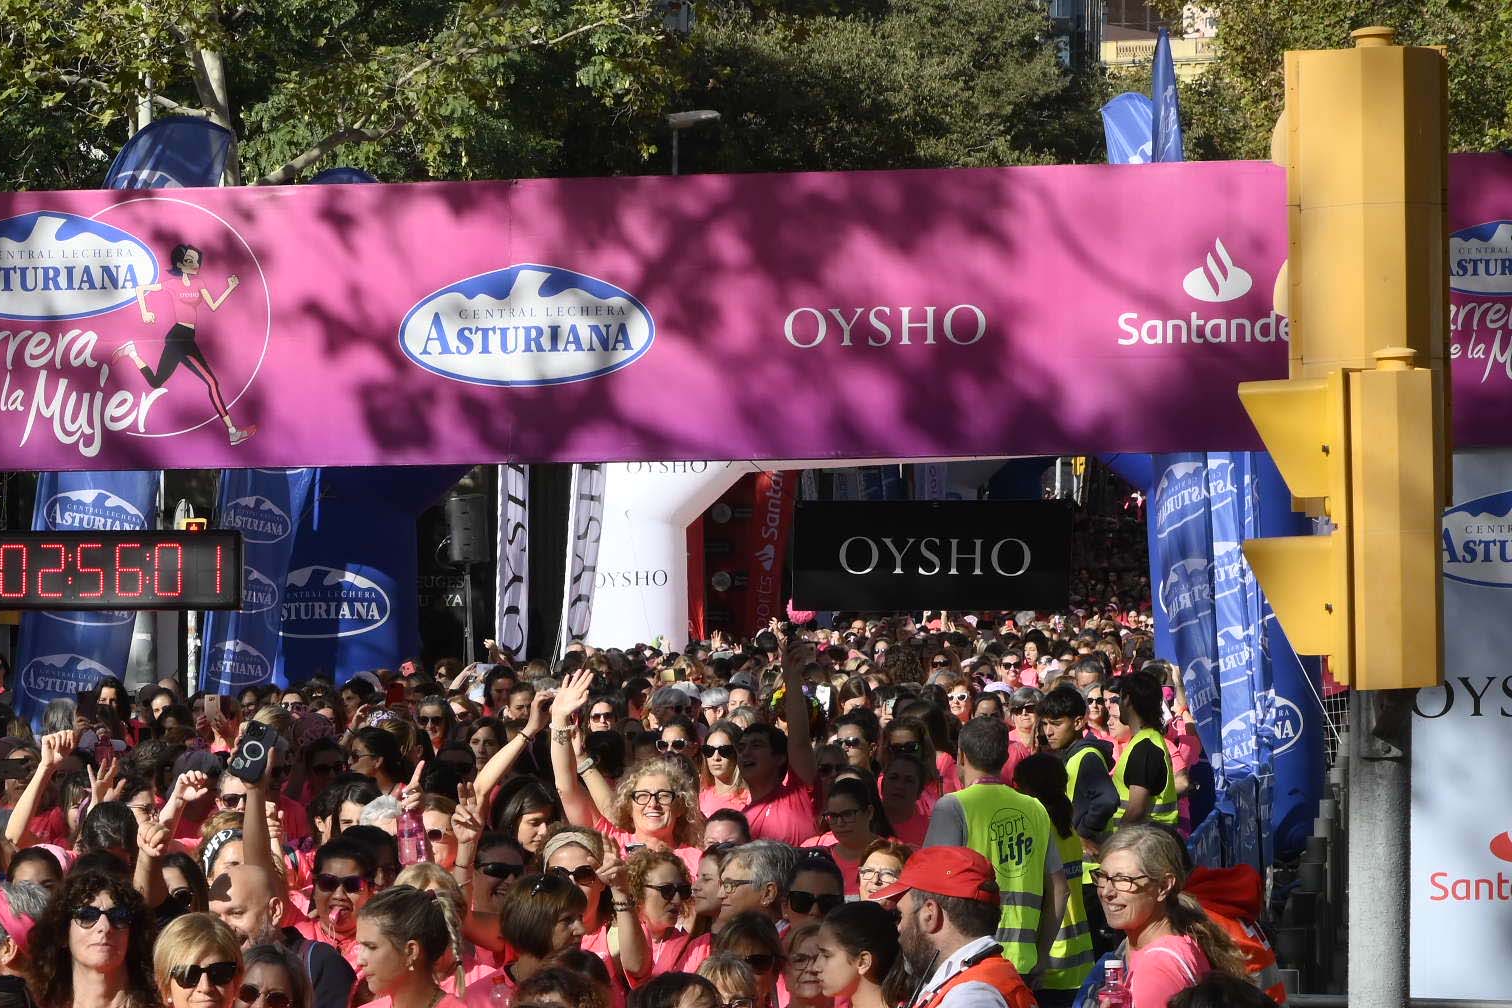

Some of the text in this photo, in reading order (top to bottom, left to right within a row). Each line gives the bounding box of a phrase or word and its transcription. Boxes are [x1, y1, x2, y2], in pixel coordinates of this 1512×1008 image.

[61, 248, 135, 258] LECHERA
[458, 304, 626, 320] CENTRAL LECHERA
[784, 304, 987, 349] OYSHO
[418, 311, 634, 356] ASTURIANA
[1468, 331, 1486, 359] la
[0, 371, 25, 412] la
[19, 364, 169, 457] Mujer
[0, 543, 221, 597] 02:56:01
[838, 536, 1032, 577] OYSHO
[327, 590, 377, 599] LECHERA
[281, 601, 381, 622] STURIANA
[990, 815, 1026, 842] Sport
[998, 831, 1034, 865] Life
